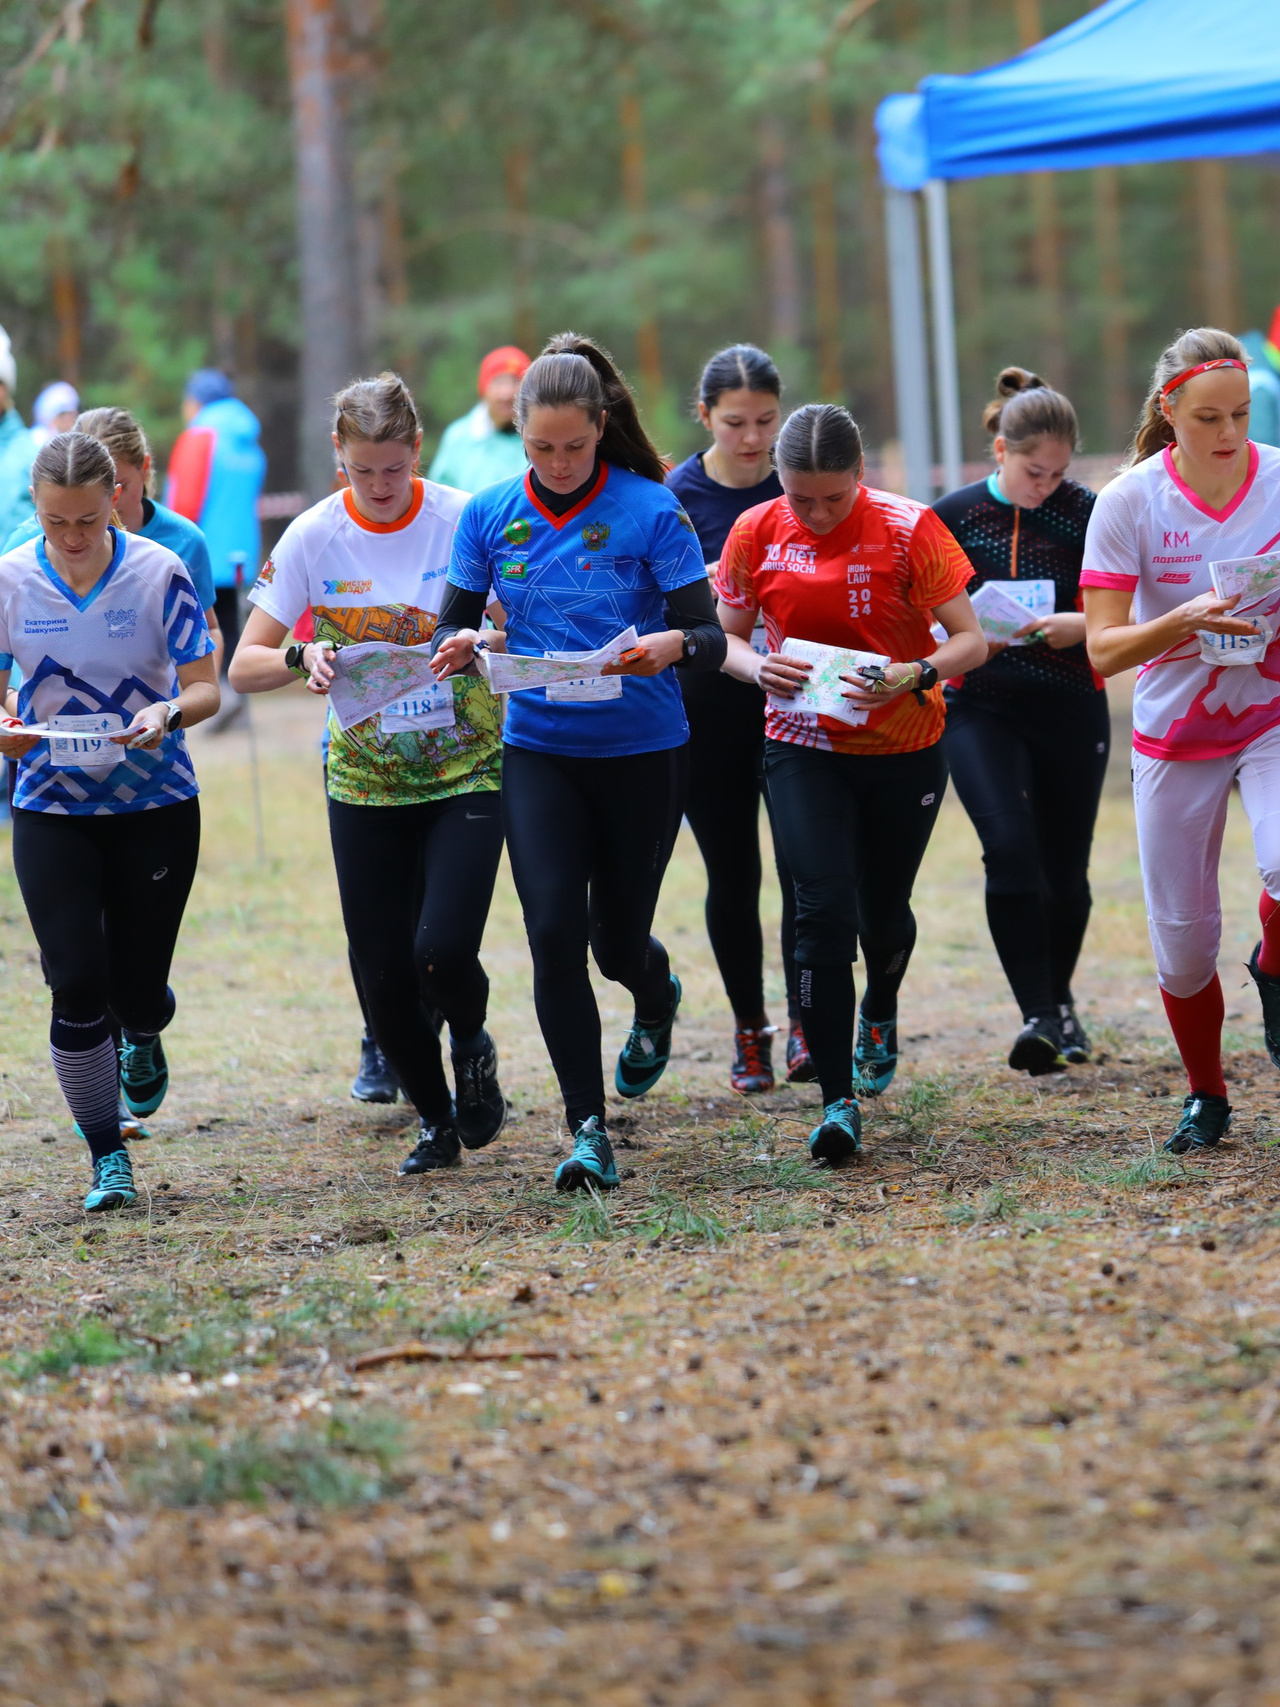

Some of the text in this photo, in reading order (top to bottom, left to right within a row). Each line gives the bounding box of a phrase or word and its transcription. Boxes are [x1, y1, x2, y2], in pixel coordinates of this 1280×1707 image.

[1152, 554, 1202, 564] noname
[787, 562, 816, 574] SOCHI
[847, 564, 864, 573] IRON
[847, 573, 871, 584] LADY
[848, 588, 871, 603] 20
[849, 603, 872, 618] 24
[25, 618, 67, 626] Екатерина
[24, 626, 69, 634] Шавкунова
[107, 631, 135, 639] ЮУрГУ
[1220, 634, 1250, 650] 115
[402, 699, 432, 717] 118
[72, 739, 102, 752] 119
[800, 969, 812, 1008] noname
